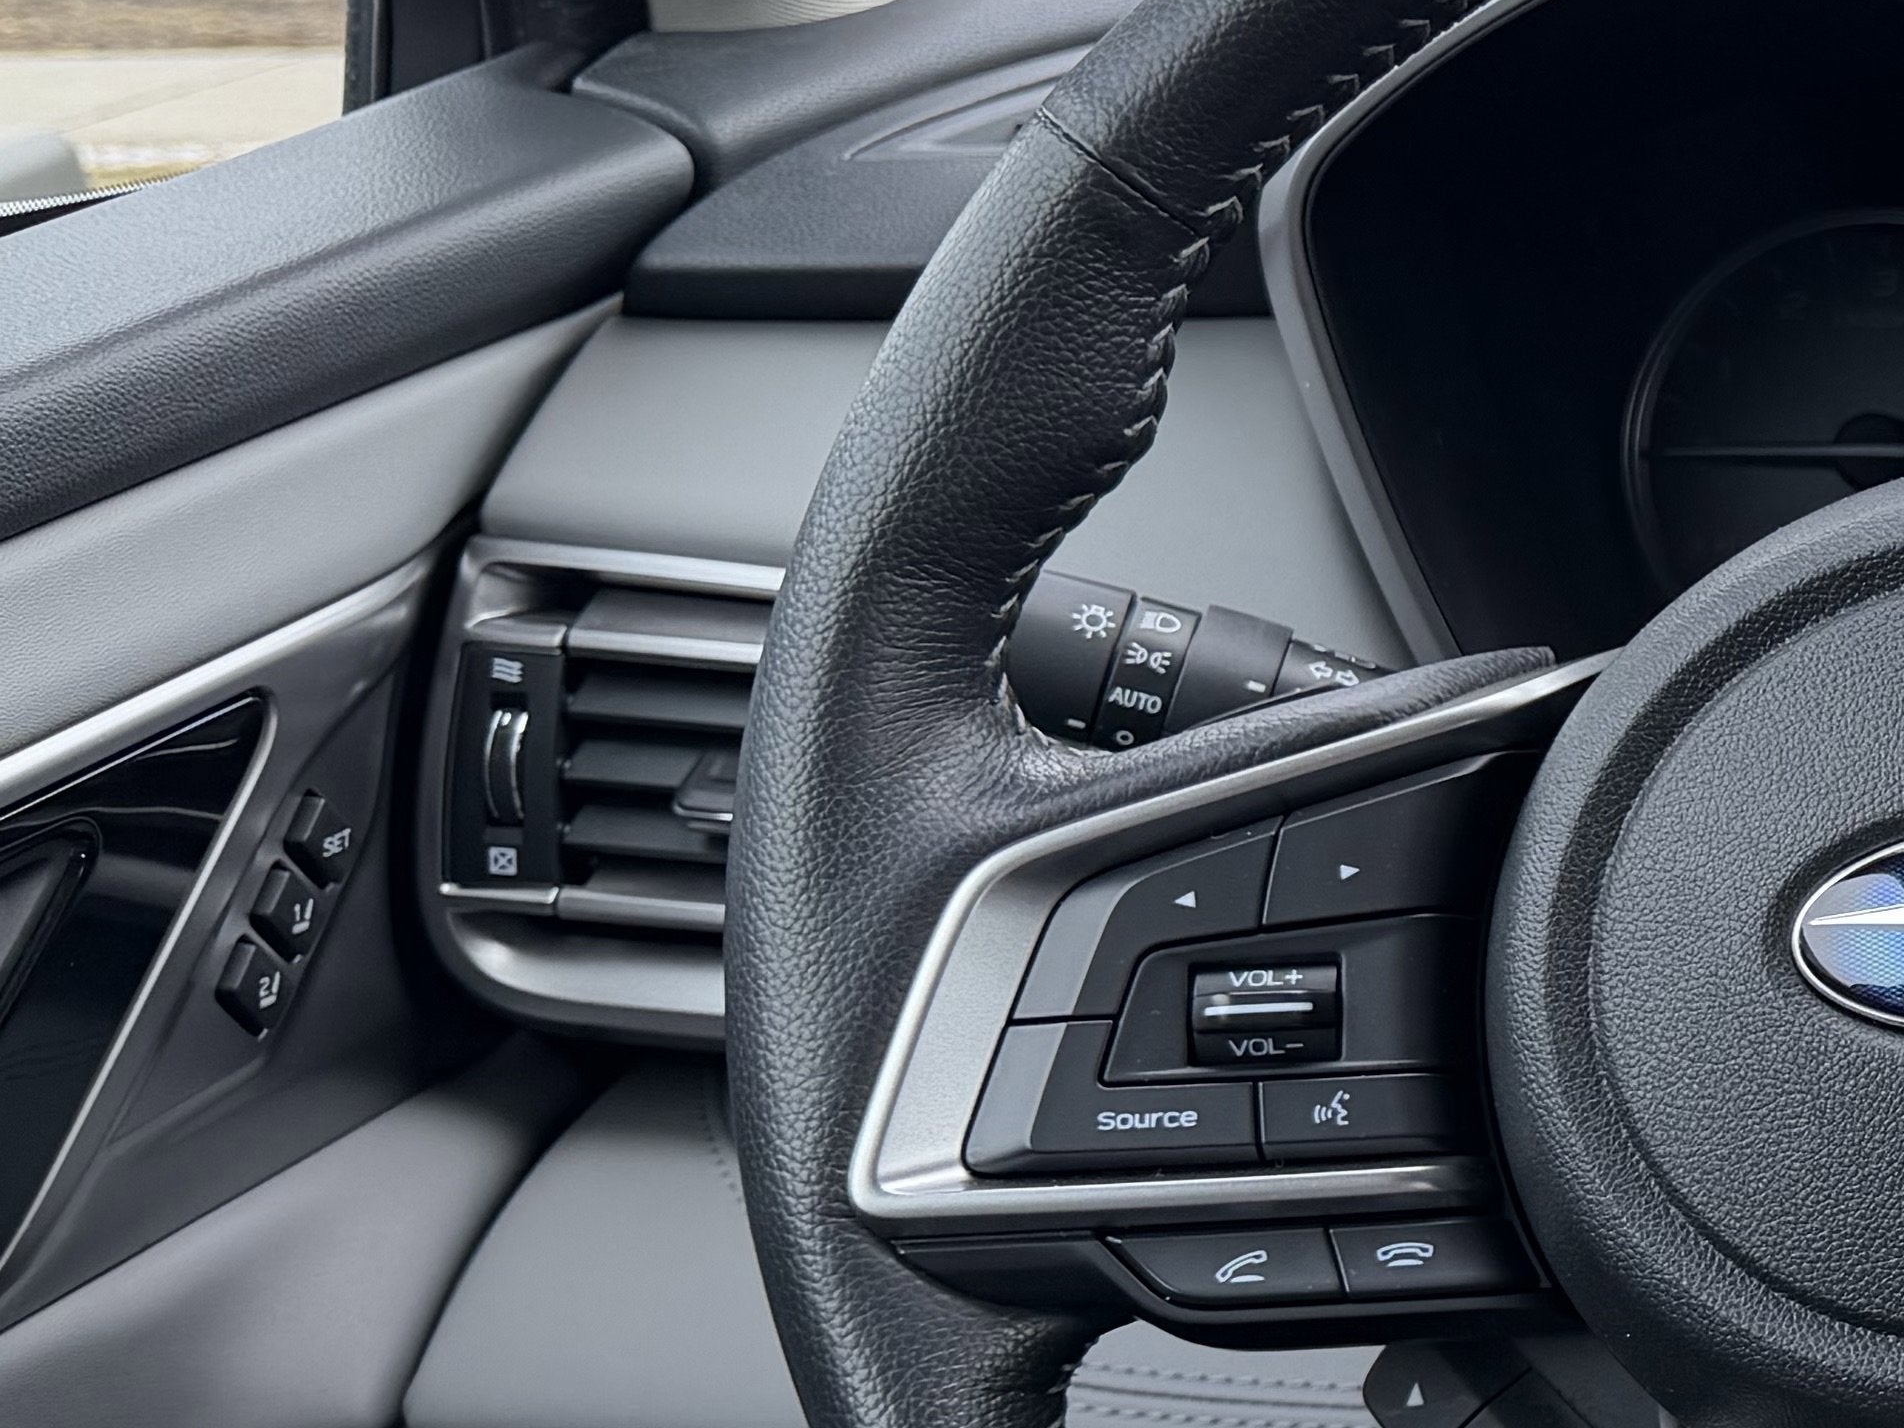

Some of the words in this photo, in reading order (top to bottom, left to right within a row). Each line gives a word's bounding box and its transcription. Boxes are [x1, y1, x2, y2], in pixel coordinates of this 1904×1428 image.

[1108, 685, 1163, 716] AUTO
[322, 827, 352, 859] SET
[1227, 968, 1304, 988] VOL+
[1097, 1105, 1199, 1132] Source
